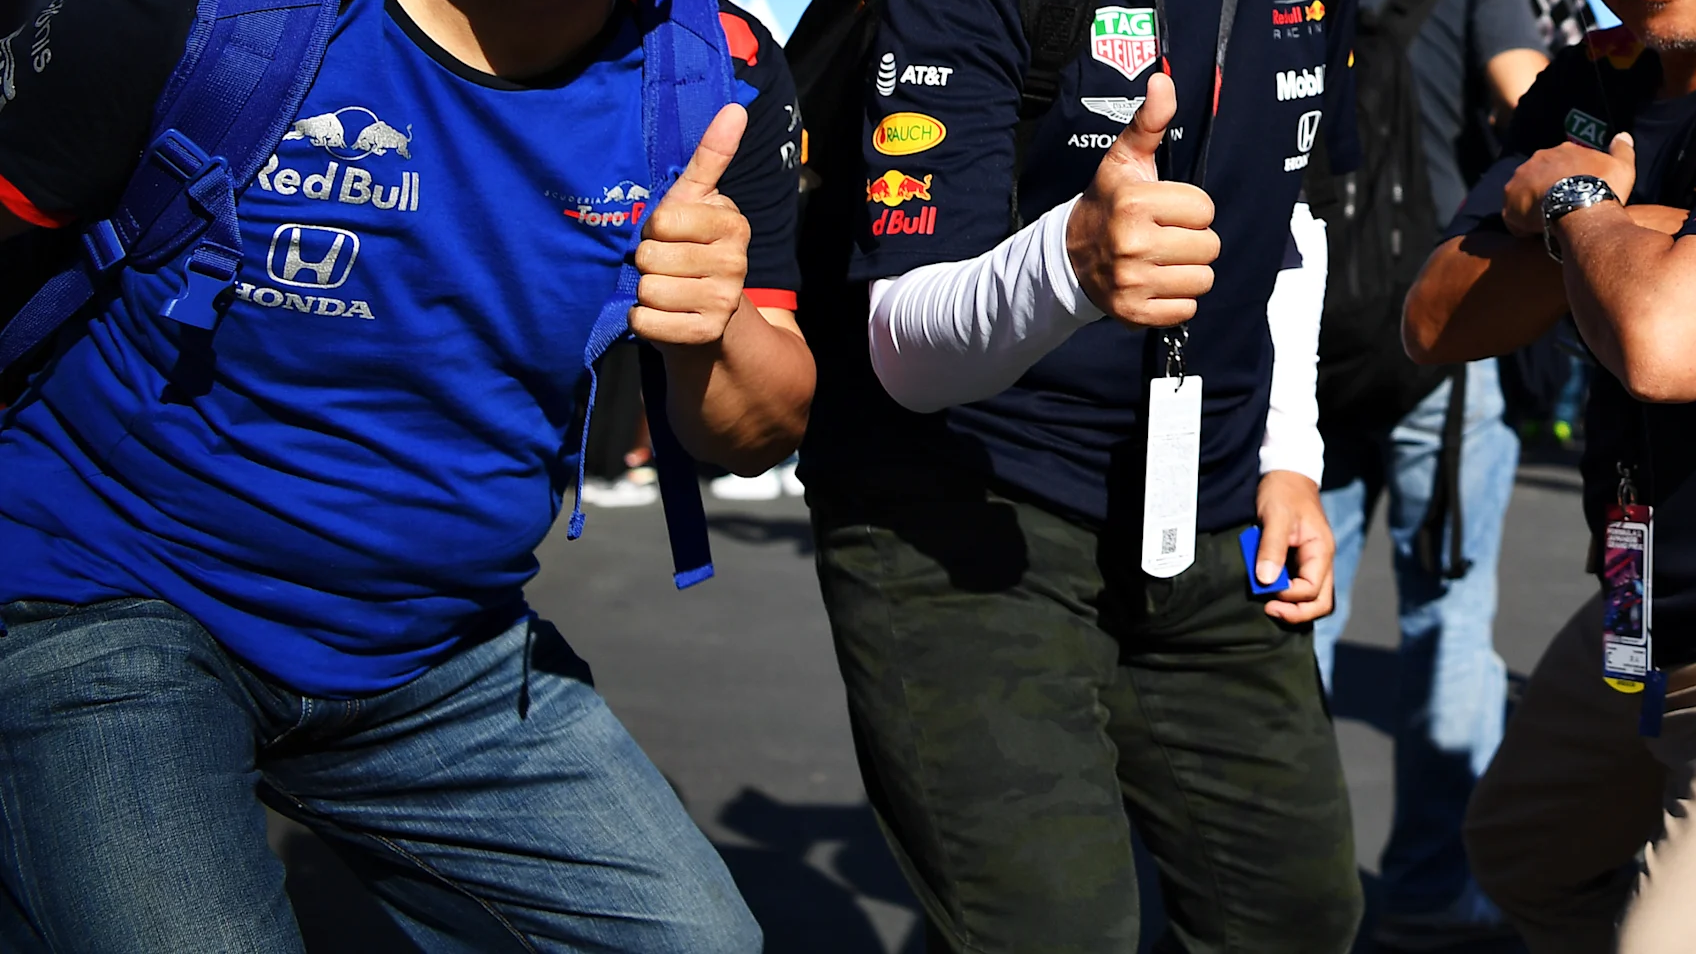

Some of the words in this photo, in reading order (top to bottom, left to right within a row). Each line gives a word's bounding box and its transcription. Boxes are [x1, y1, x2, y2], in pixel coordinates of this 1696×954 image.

[1101, 9, 1153, 36] TAG
[1099, 39, 1158, 73] HEUER
[900, 64, 954, 87] AT&T
[886, 121, 934, 142] RAUCH
[1068, 133, 1119, 149] ASTO
[257, 152, 340, 201] Red
[338, 165, 420, 212] Bull
[543, 189, 602, 206] SCUDERIA
[577, 203, 625, 228] Toro
[889, 206, 938, 236] Bull
[235, 280, 376, 321] HONDA
